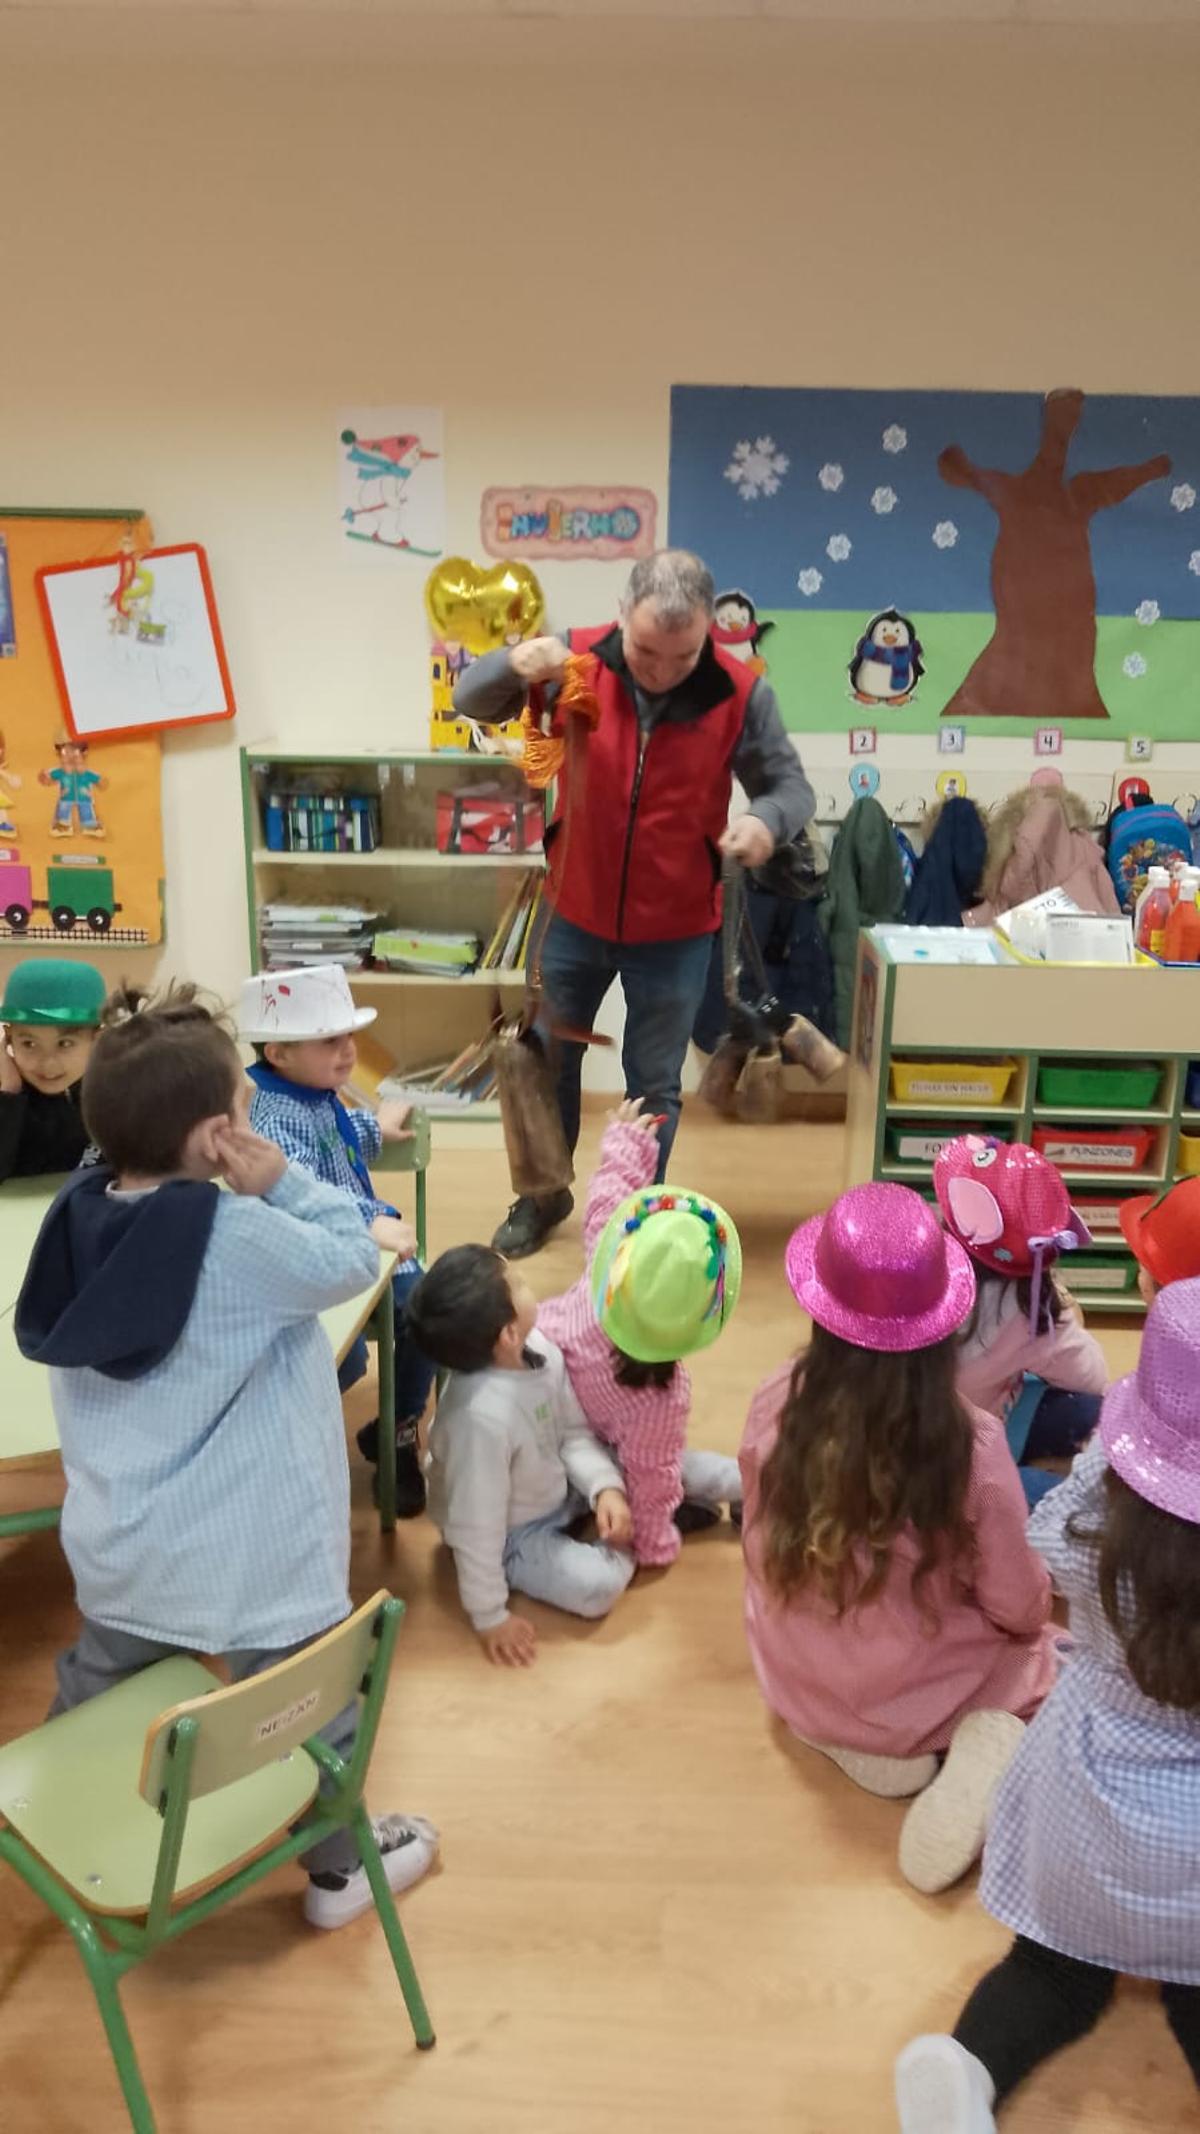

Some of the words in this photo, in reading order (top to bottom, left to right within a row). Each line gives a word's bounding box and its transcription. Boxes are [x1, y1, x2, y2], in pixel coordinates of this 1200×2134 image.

[858, 735, 868, 748] 2
[947, 733, 956, 746] 3
[1043, 735, 1053, 749] 4
[1136, 741, 1145, 754] 5
